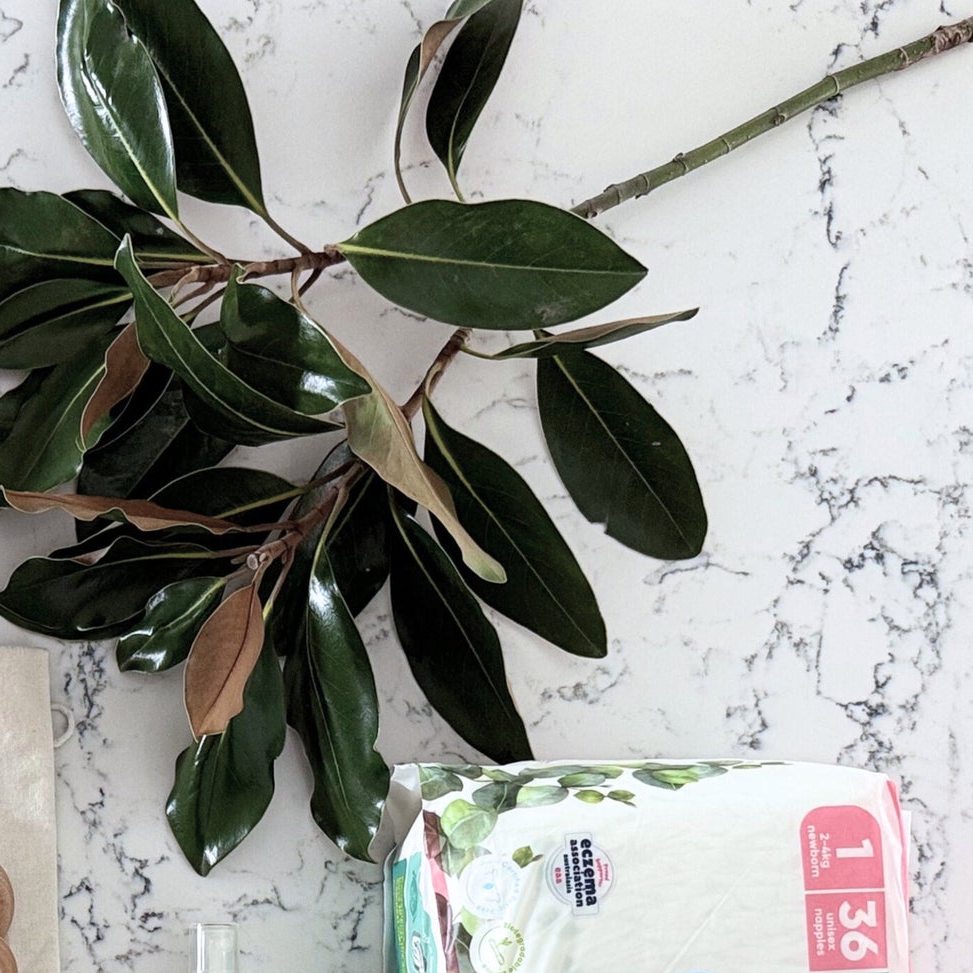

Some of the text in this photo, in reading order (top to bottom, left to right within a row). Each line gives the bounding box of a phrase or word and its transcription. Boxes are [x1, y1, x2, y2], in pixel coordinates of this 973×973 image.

[569, 839, 585, 908] association
[580, 838, 597, 906] eczema
[807, 824, 819, 878] newborn
[835, 838, 874, 858] 1
[813, 908, 825, 956] nappies
[826, 912, 835, 952] unisex
[839, 900, 878, 962] 36
